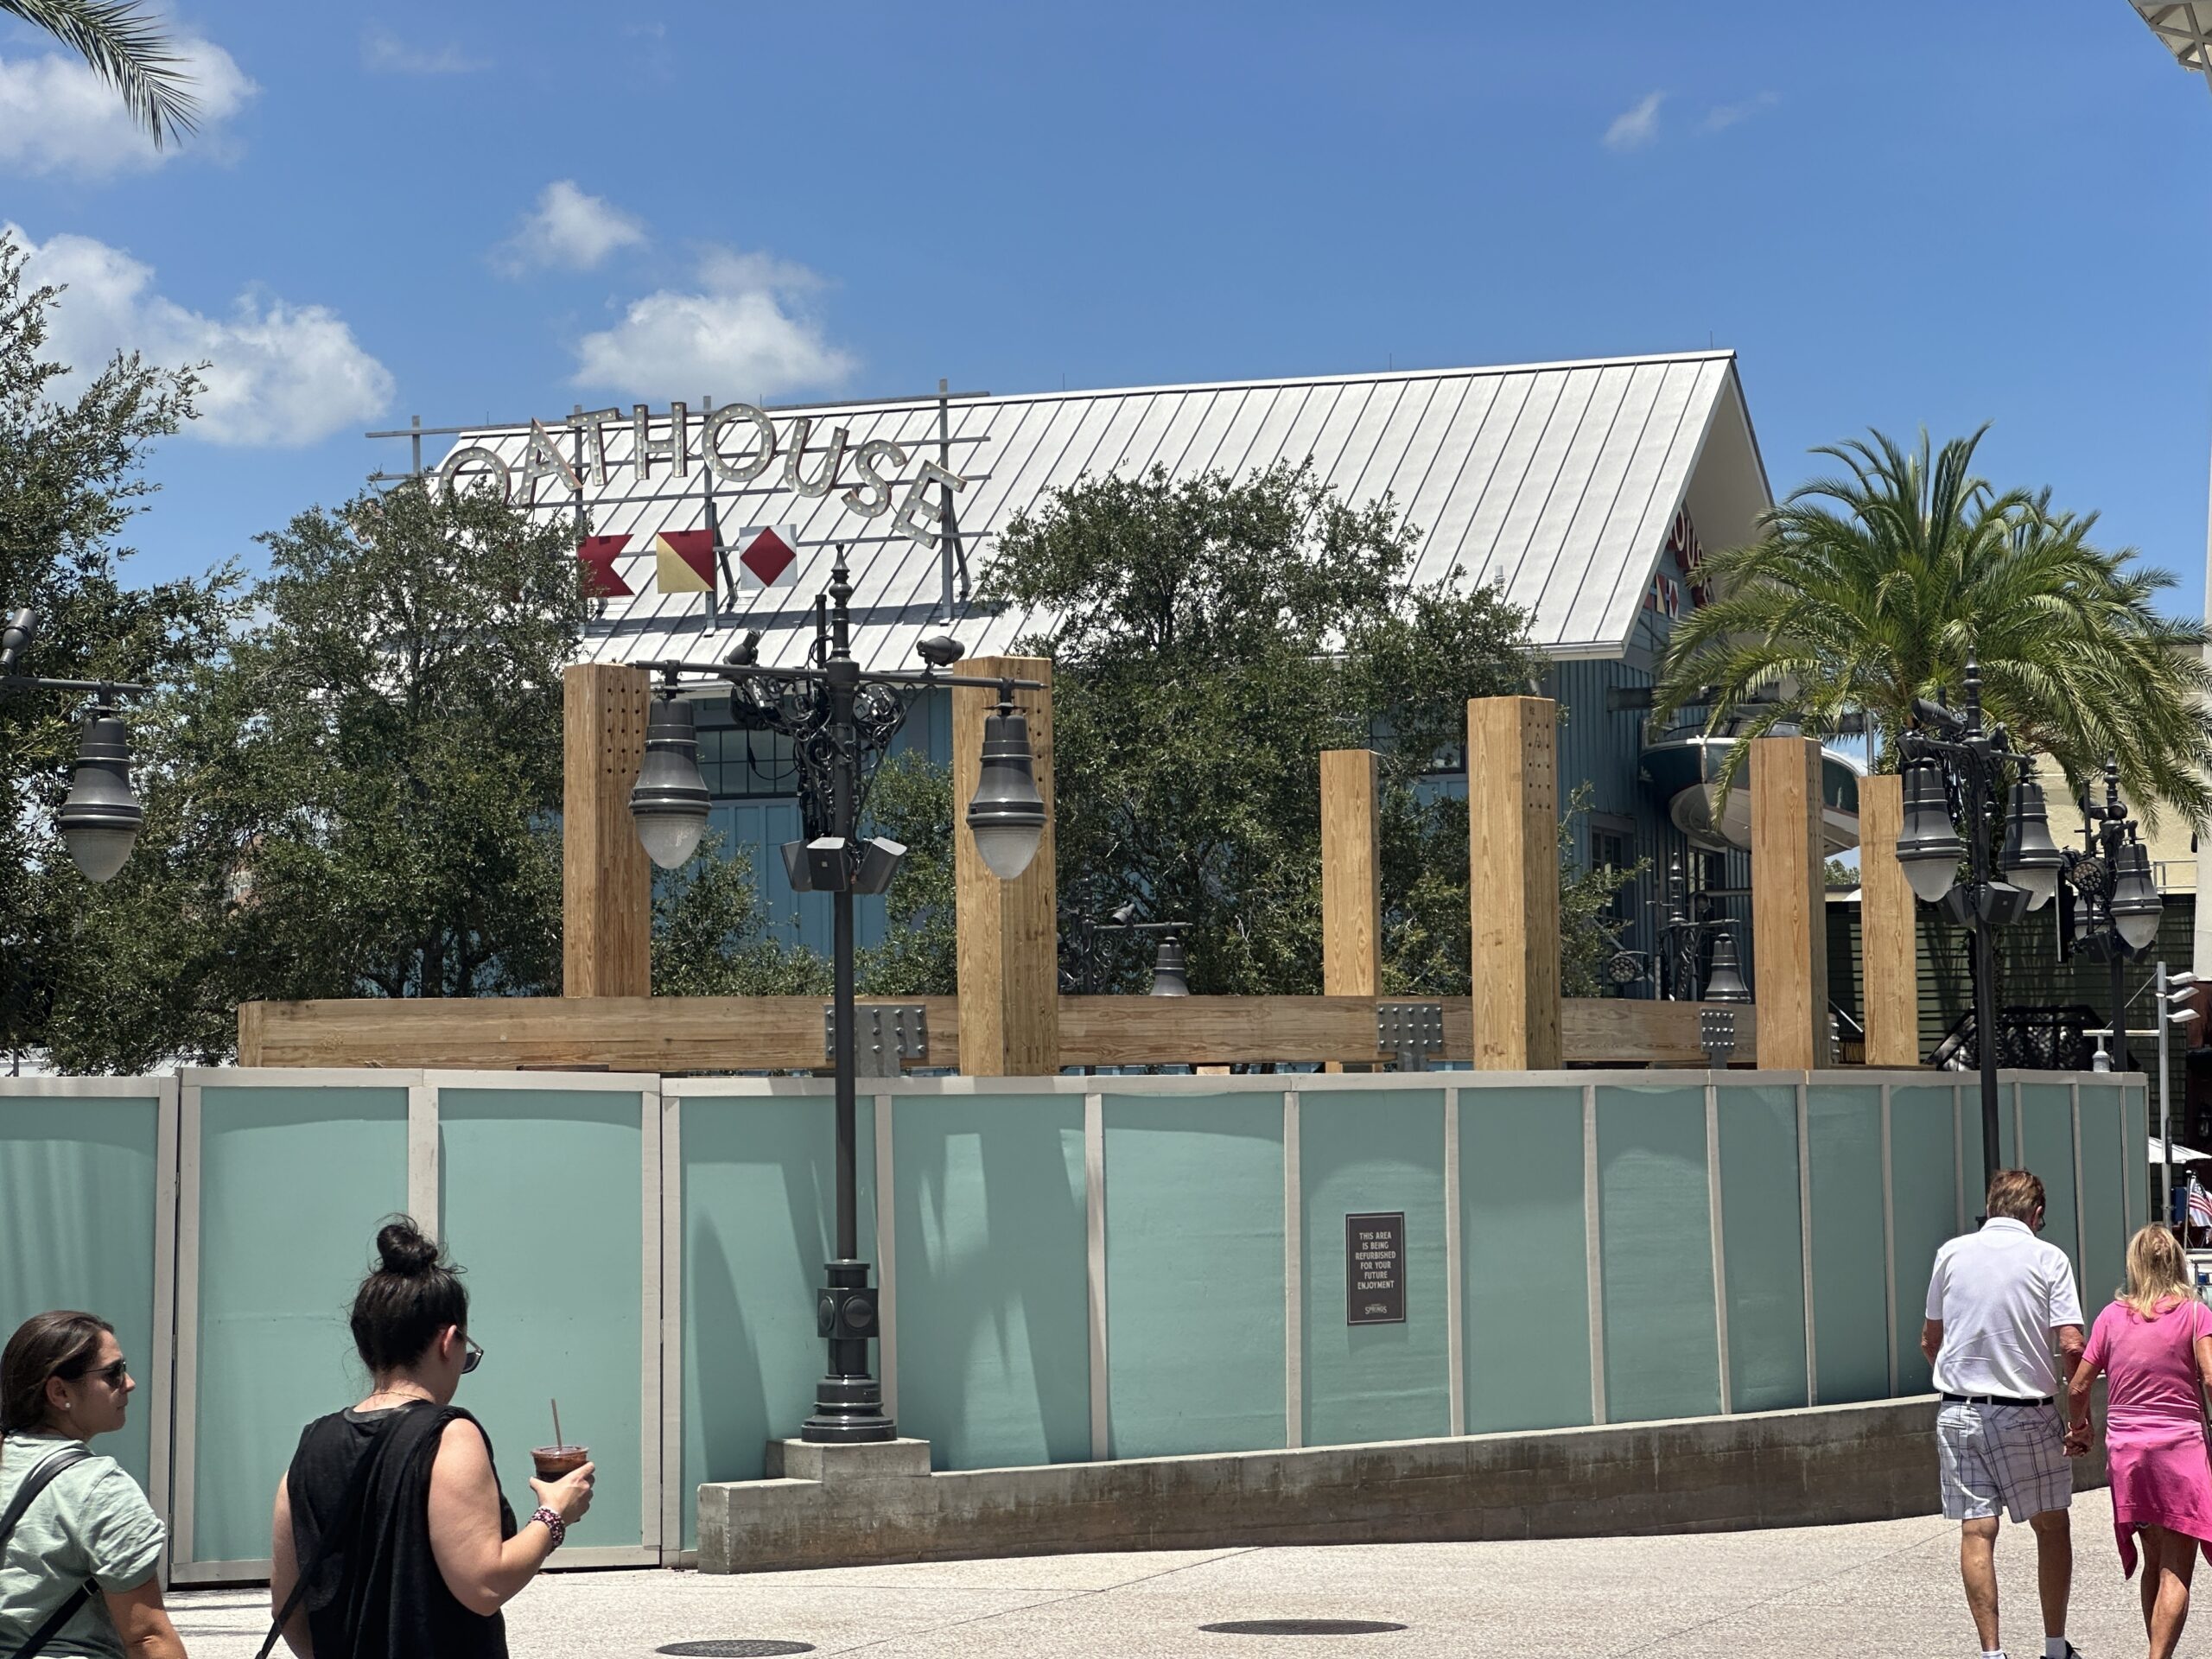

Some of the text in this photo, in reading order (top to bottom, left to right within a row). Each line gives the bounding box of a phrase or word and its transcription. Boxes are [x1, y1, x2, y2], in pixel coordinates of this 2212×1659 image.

[381, 402, 967, 550] OATHOUSE
[1359, 1231, 1392, 1240] THIS AREA
[1362, 1242, 1369, 1250] IS
[1355, 1251, 1396, 1260] REFURBISHED
[1360, 1261, 1392, 1269] FOR YOUR
[1364, 1271, 1388, 1280] FUTURE
[1357, 1280, 1395, 1290] ENJOYMENT
